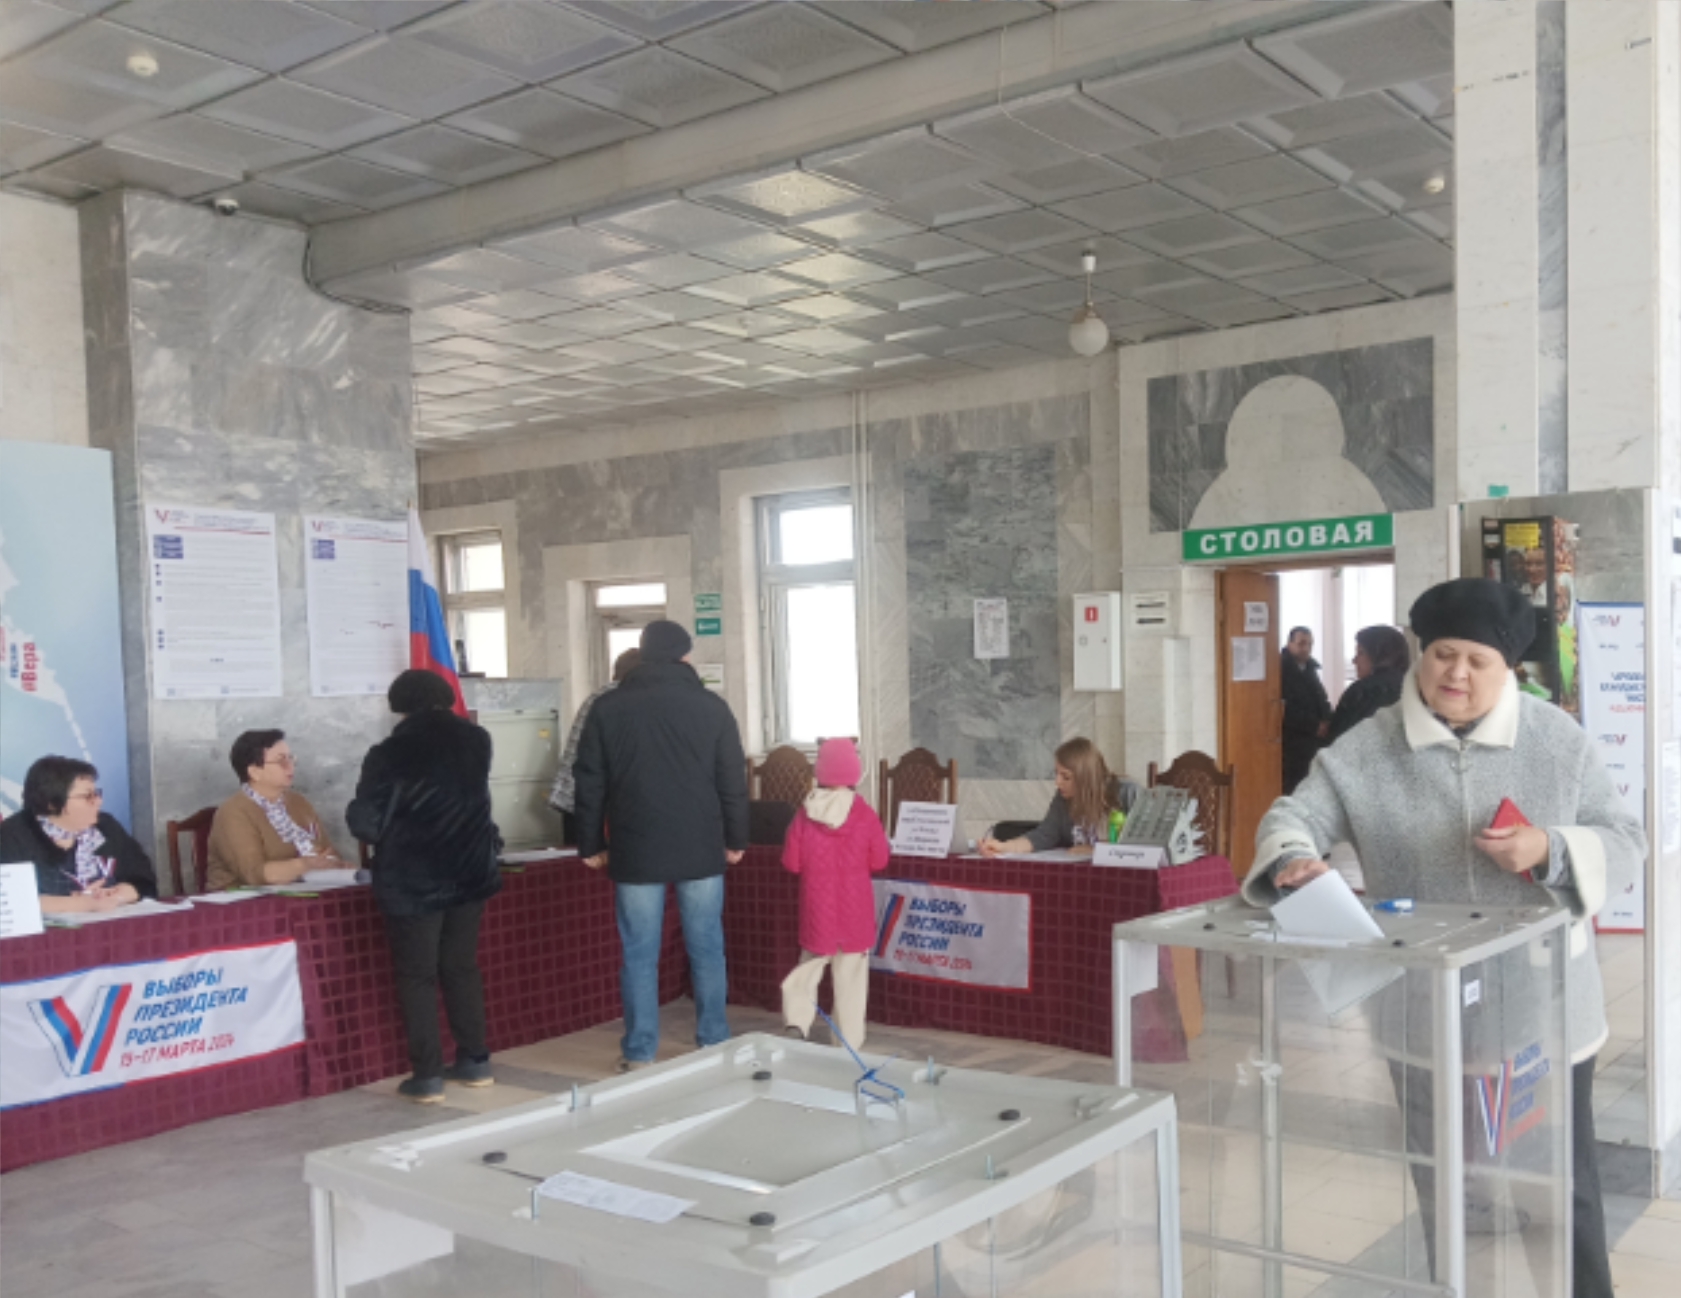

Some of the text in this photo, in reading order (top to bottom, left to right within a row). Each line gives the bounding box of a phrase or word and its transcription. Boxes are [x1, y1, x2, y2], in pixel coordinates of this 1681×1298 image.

[1199, 520, 1375, 556] СТОЛОВАЯ
[908, 896, 967, 917] ВЫБОРЫ
[903, 913, 984, 939] ПРЕЗИДЕНТА
[898, 930, 950, 952] РОССИИ
[142, 967, 224, 997] ВЫБОРЫ
[133, 986, 249, 1023] ПРЕЗИДЕНТА
[124, 1017, 203, 1048] РОССИИ
[155, 1038, 206, 1063] МАРТА
